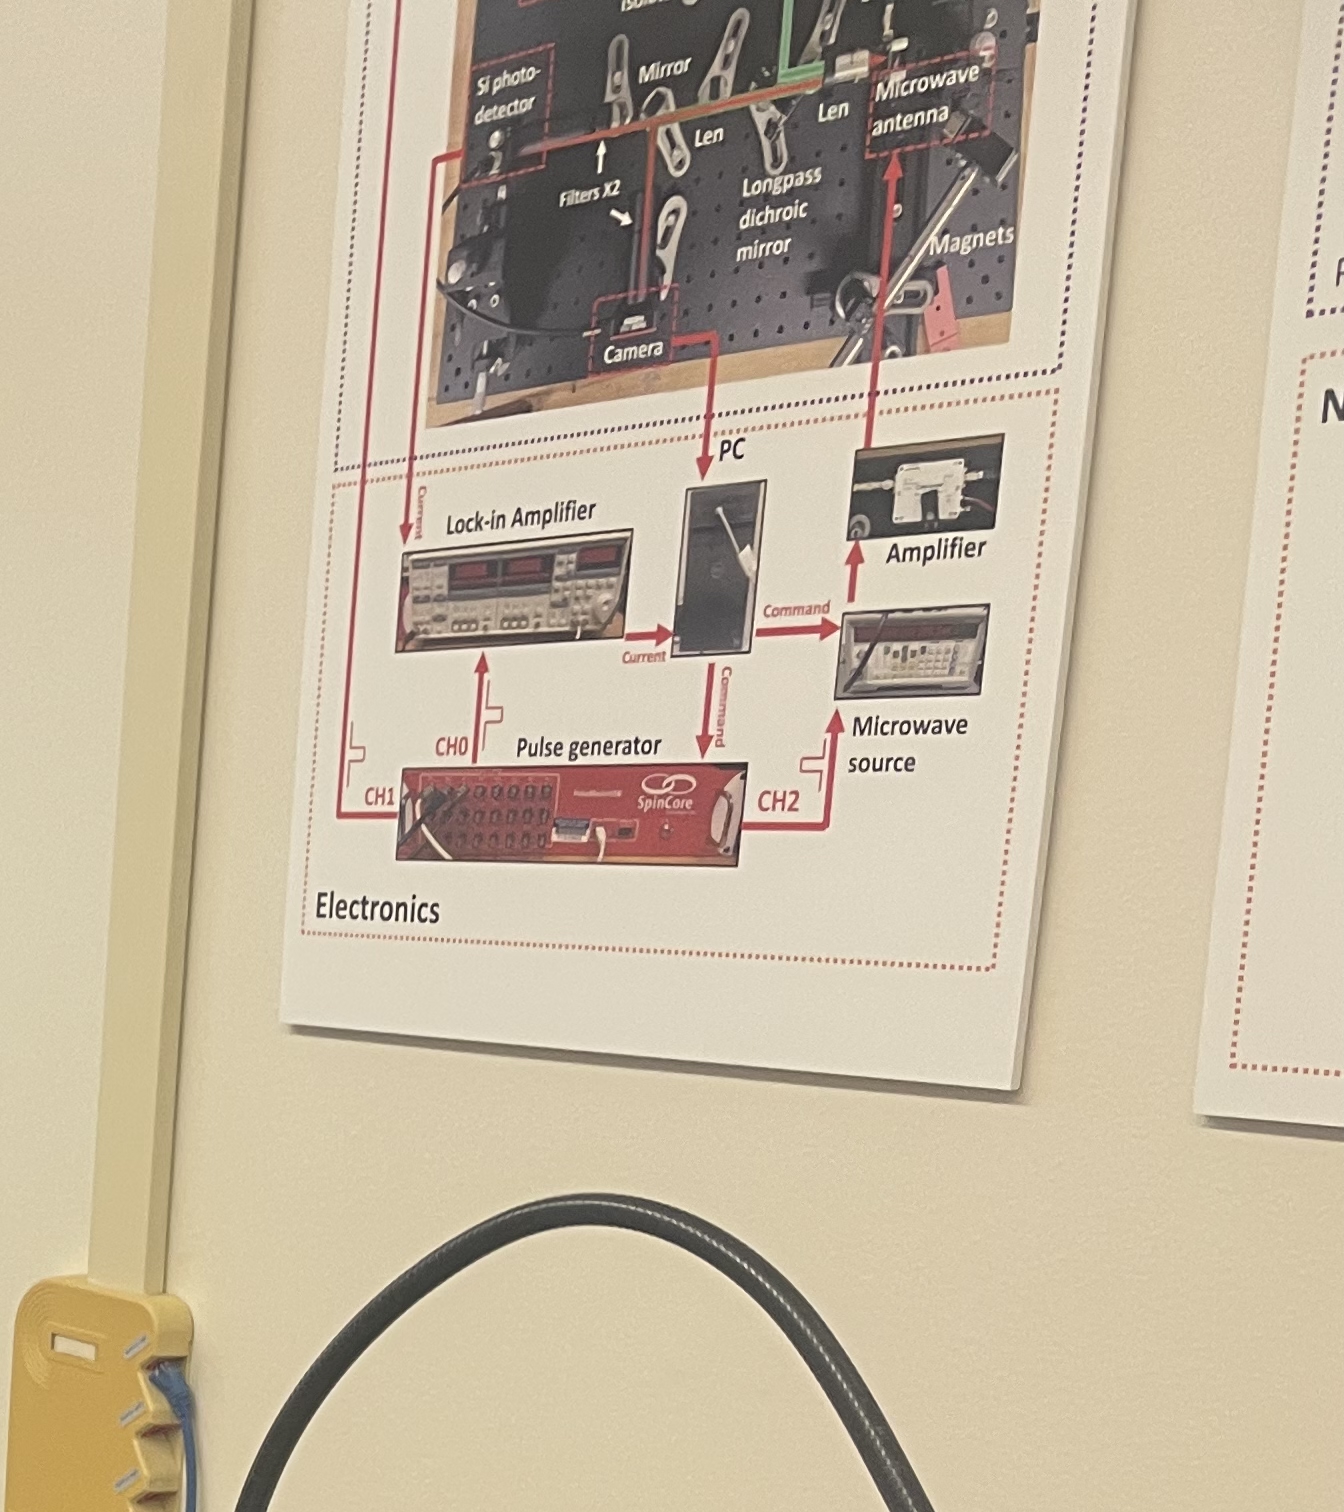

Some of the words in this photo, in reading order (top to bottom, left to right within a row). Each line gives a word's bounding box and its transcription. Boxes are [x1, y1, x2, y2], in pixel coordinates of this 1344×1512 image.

[476, 76, 490, 96] Si
[492, 66, 541, 95] photo-
[639, 57, 692, 84] Mirror
[874, 63, 980, 102] Microwave
[474, 94, 537, 125] detector
[818, 103, 849, 123] Len
[872, 104, 949, 136] antenna
[694, 126, 724, 148] Len
[559, 186, 600, 208] Filters
[602, 179, 620, 200] X2
[742, 165, 822, 199] Longpass
[739, 200, 808, 231] dichroic
[736, 236, 791, 263] mirror
[929, 225, 1015, 256] Magnets
[603, 341, 664, 365] Camera
[718, 437, 745, 462] PC
[414, 485, 428, 541] Current
[446, 510, 506, 536] Lock-in
[511, 499, 597, 531] Amplifier
[885, 537, 987, 567] Amplifier
[762, 600, 831, 618] Command
[622, 650, 666, 664] Current
[714, 666, 733, 748] Command
[852, 714, 969, 738] Microwave
[516, 736, 563, 759] Pulse
[568, 736, 662, 762] generator
[848, 754, 917, 774] source
[364, 786, 395, 807] CH1
[637, 795, 693, 812] SpinCore
[757, 790, 800, 813] CH2
[315, 891, 441, 925] Electronics
